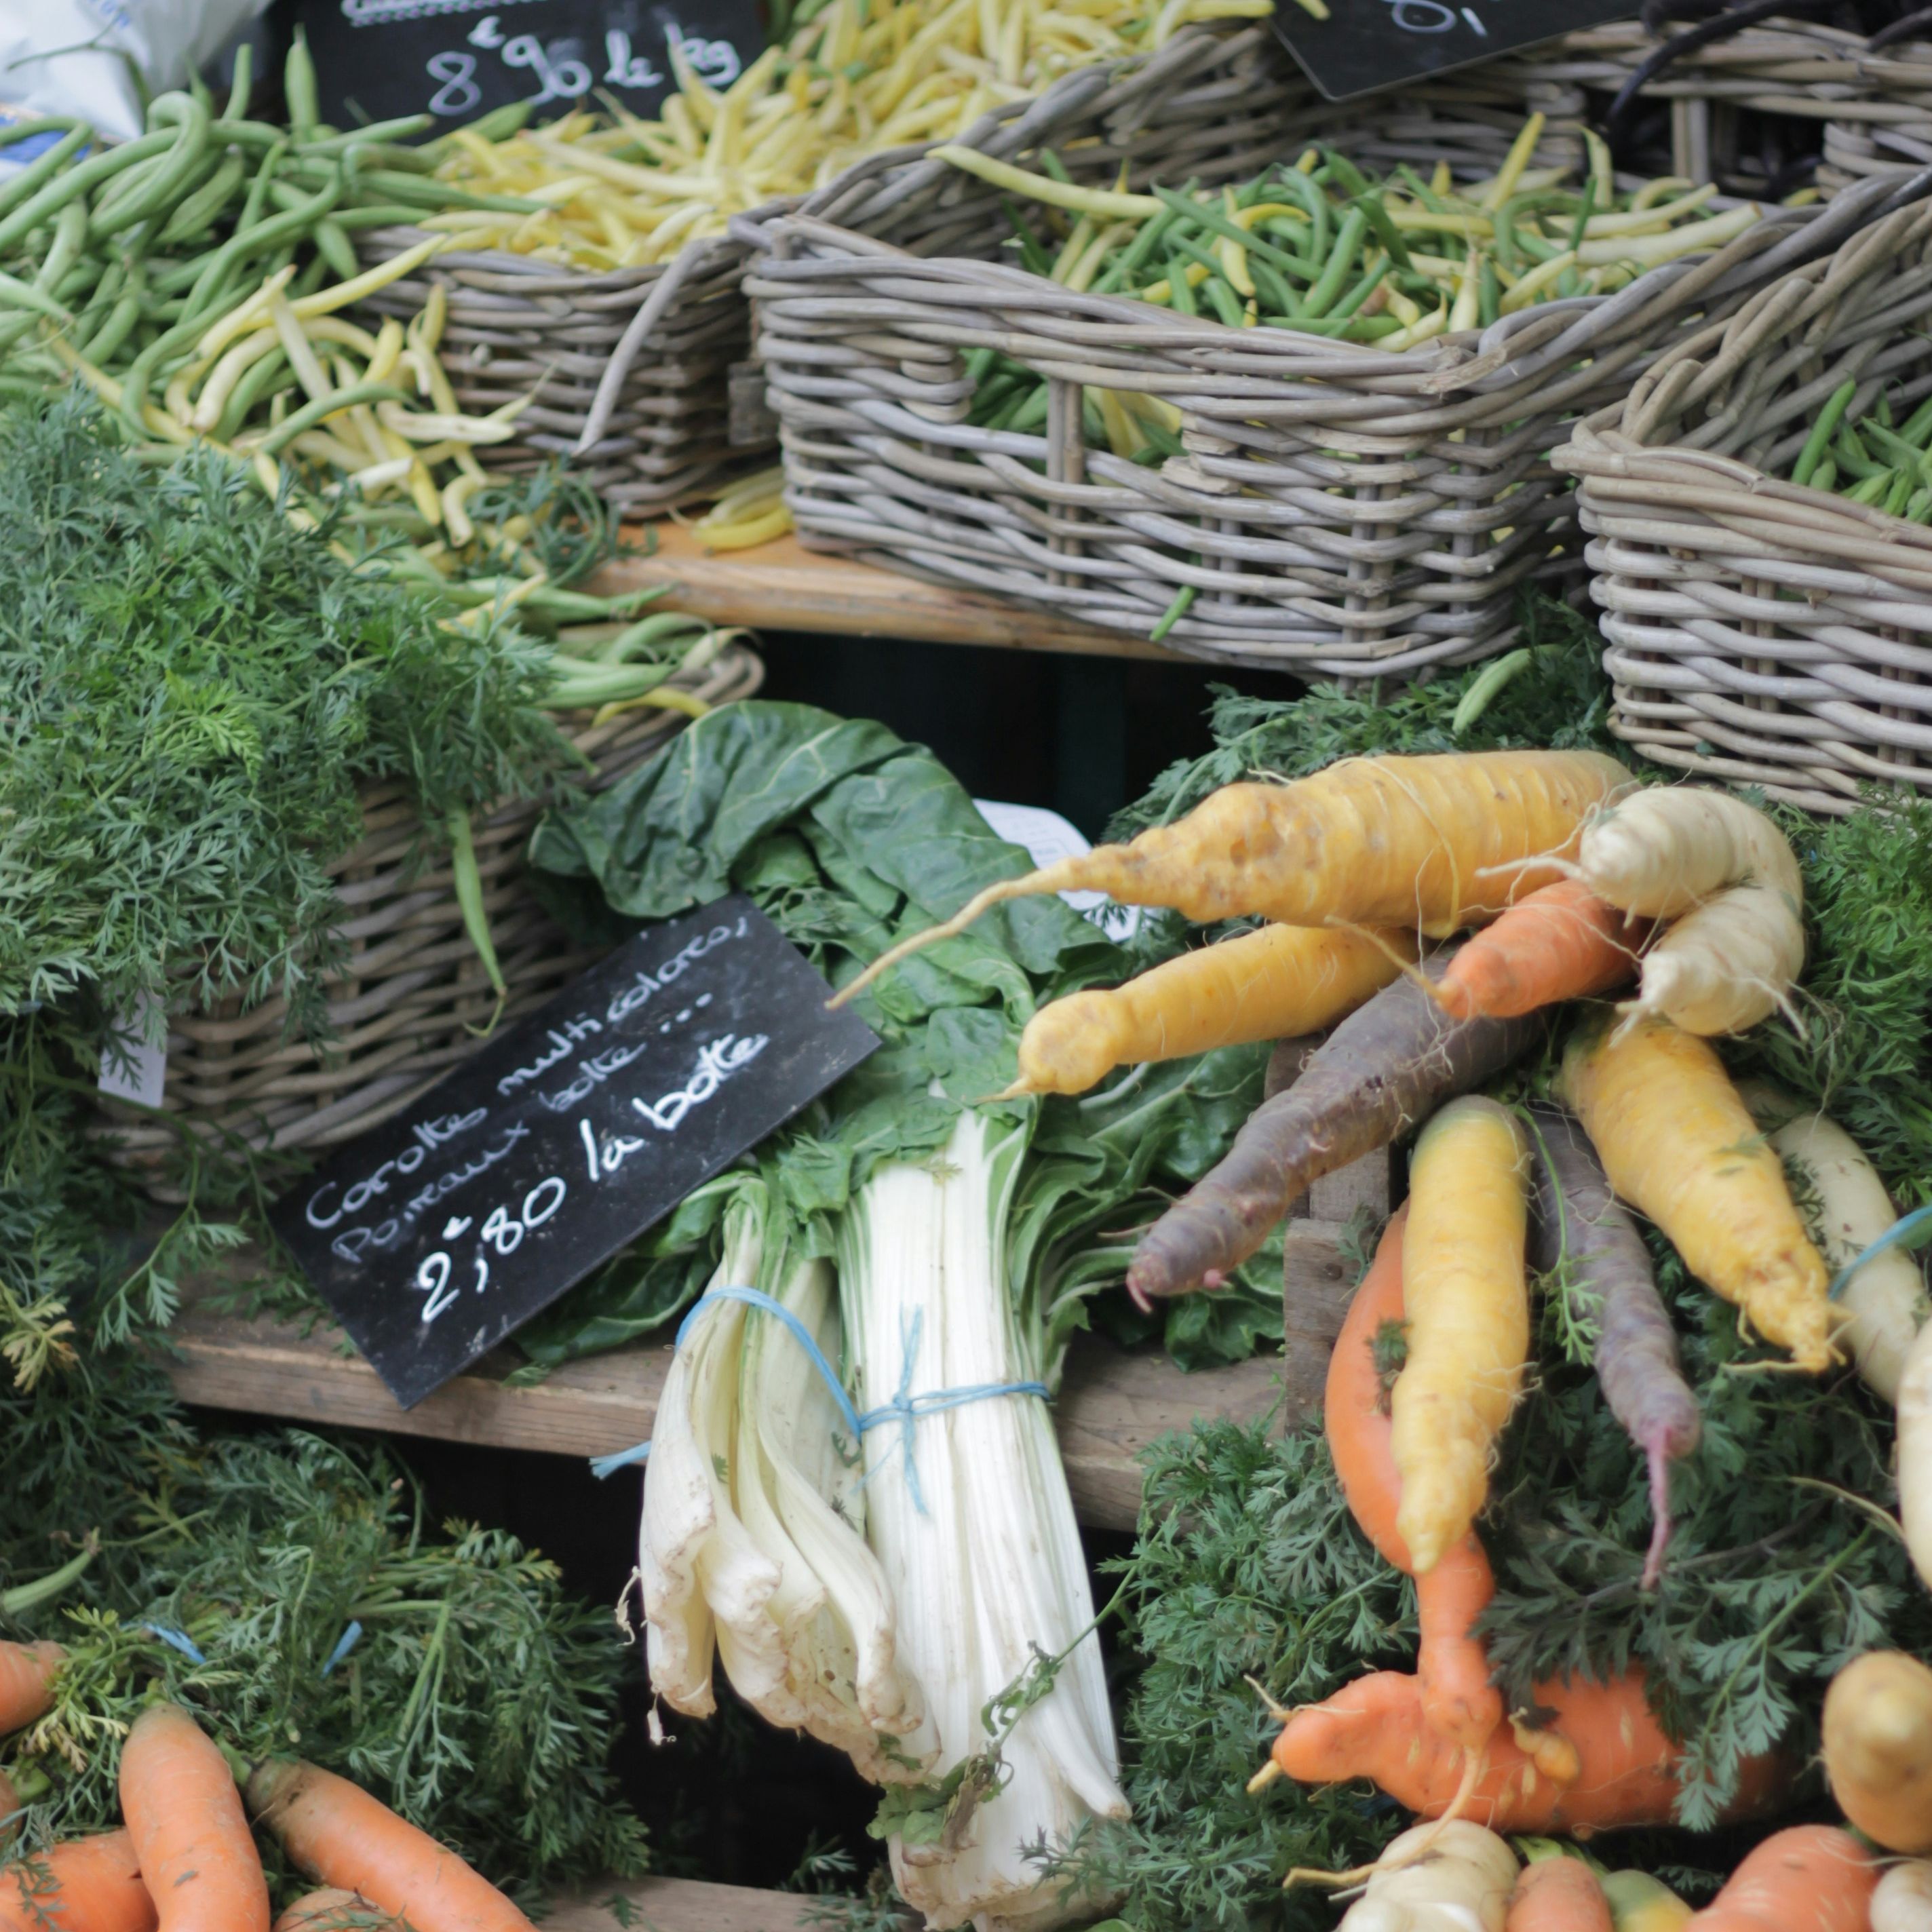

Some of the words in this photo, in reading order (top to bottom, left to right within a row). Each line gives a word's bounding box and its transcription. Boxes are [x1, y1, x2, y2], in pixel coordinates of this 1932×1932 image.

[603, 28, 664, 88] le
[579, 1118, 646, 1182] la
[632, 1032, 770, 1132] botte
[331, 1119, 530, 1264] Poireaux
